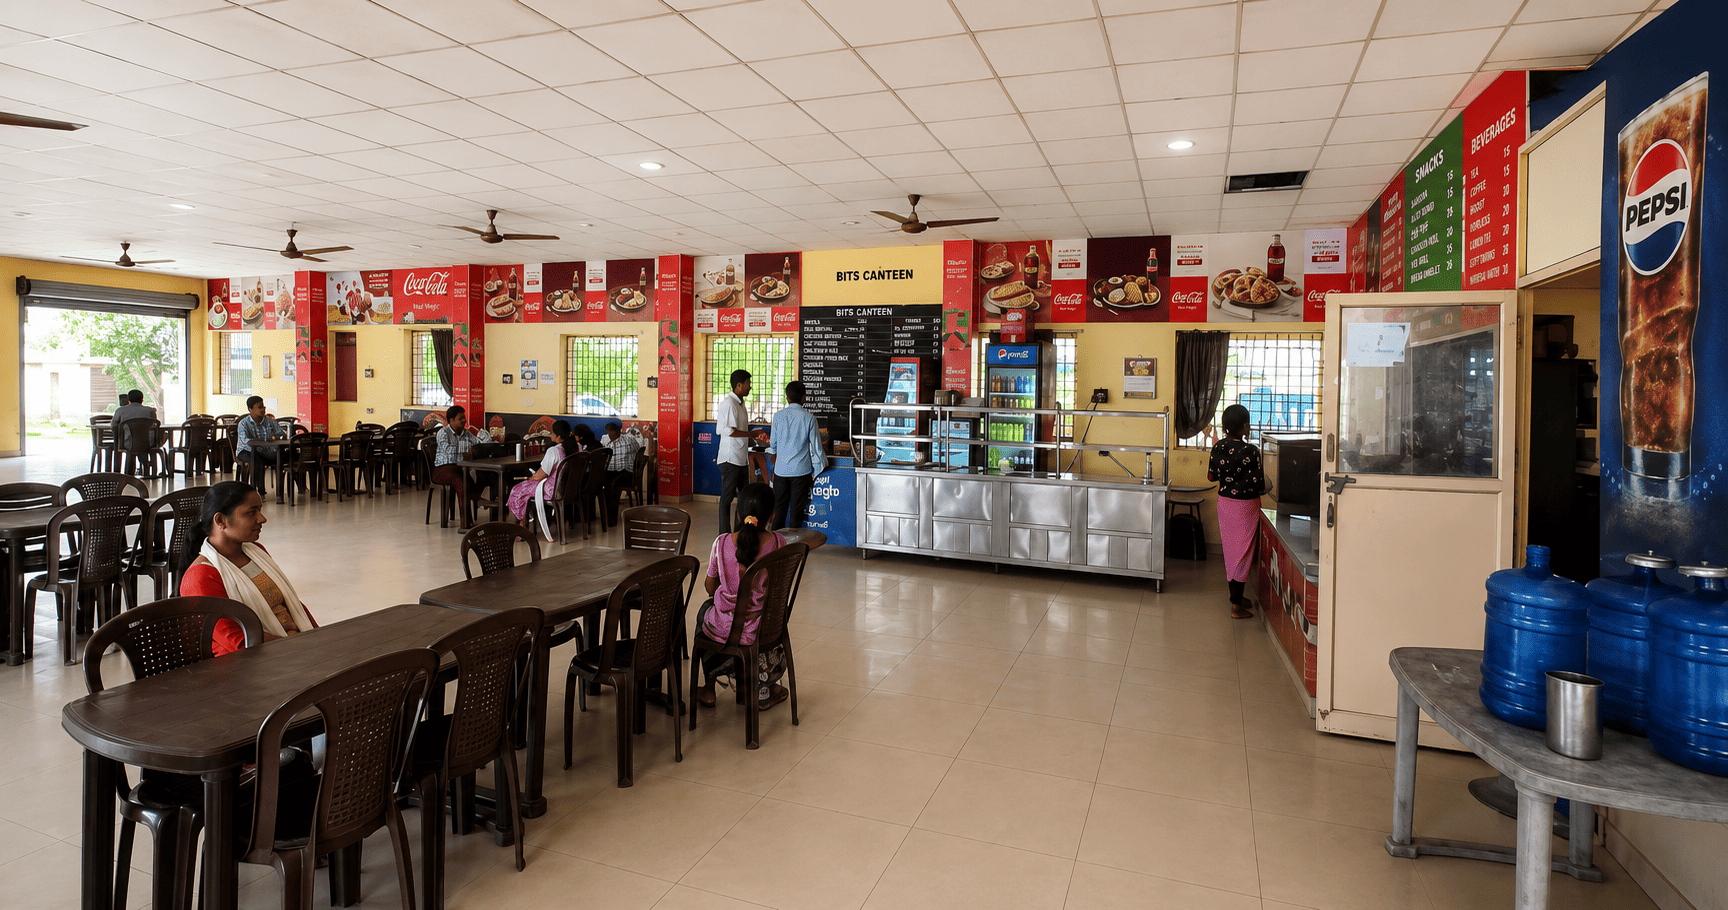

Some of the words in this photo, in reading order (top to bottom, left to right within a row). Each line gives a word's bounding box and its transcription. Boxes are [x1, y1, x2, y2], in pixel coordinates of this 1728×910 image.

[1471, 107, 1516, 155] BEVERAGES
[1415, 149, 1444, 183] SNACKS
[1625, 181, 1687, 232] PEPSI
[836, 271, 860, 281] BITS
[863, 269, 914, 280] CANTEEN
[836, 308, 854, 317] BITS
[856, 307, 893, 317] CANTEEN
